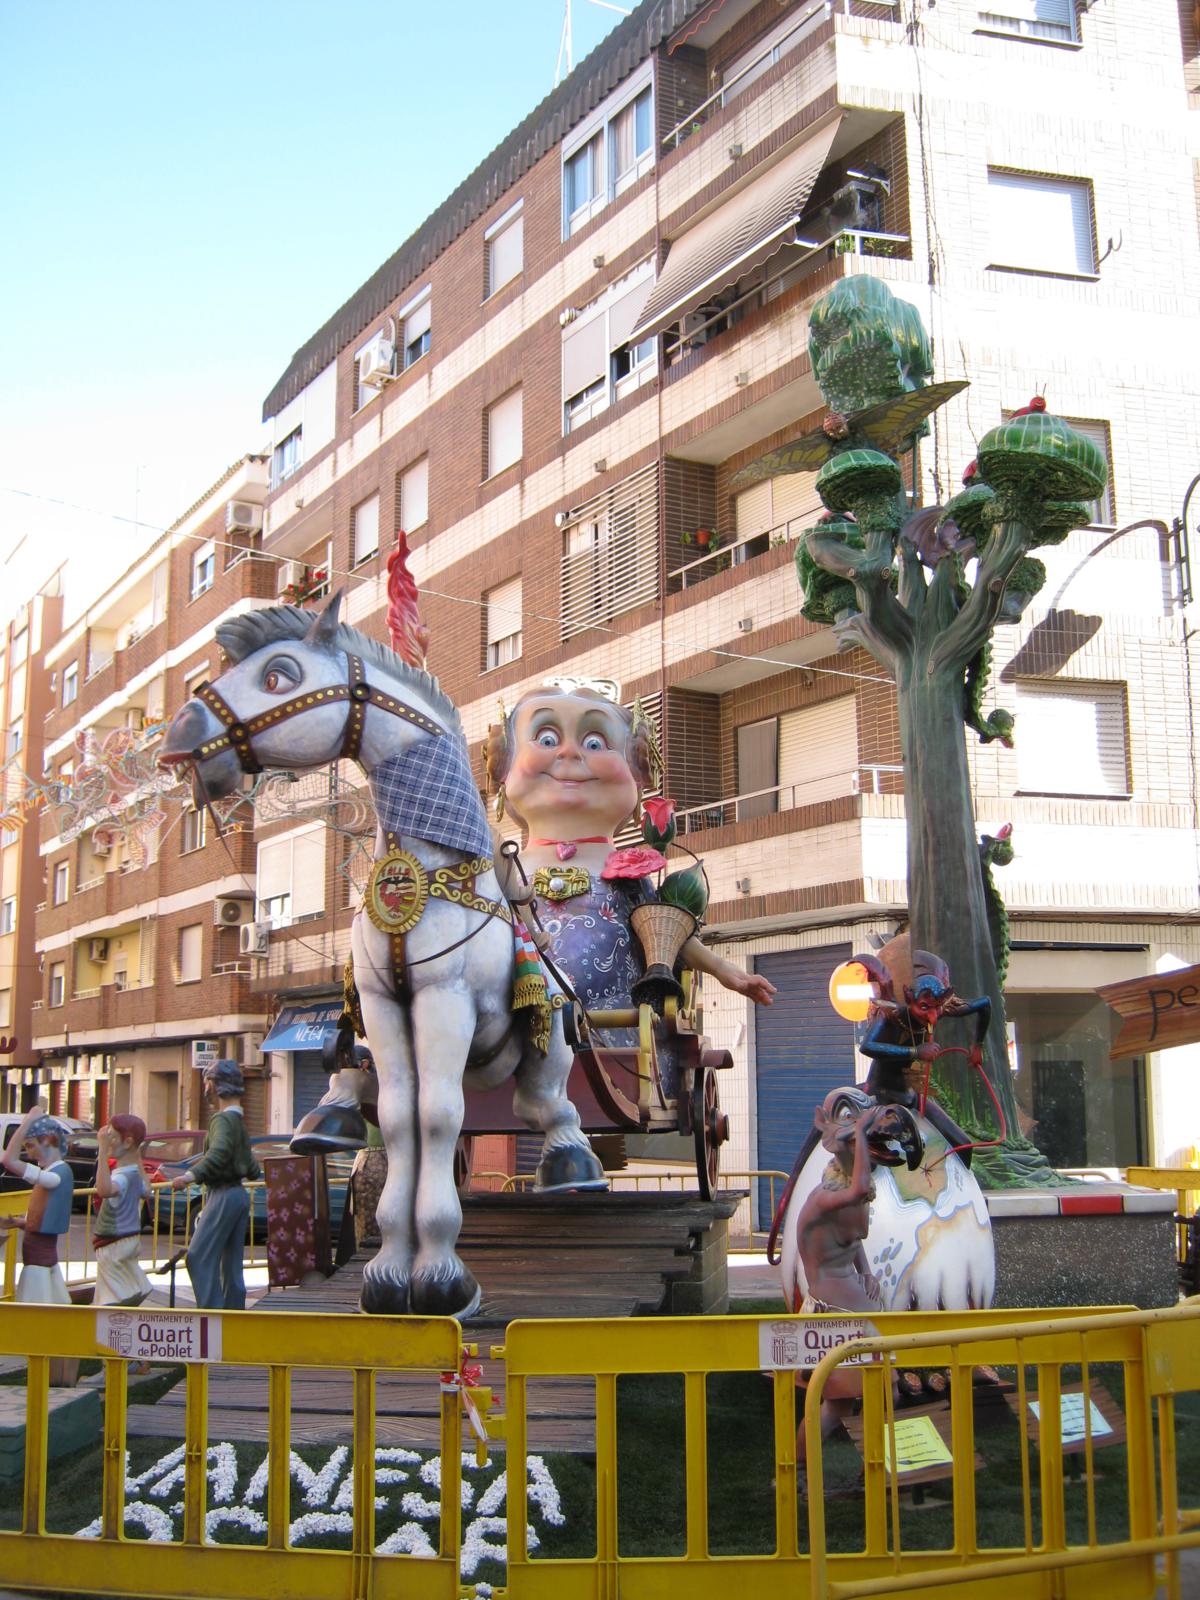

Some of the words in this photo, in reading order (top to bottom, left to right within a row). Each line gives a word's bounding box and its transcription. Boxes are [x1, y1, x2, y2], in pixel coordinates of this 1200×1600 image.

[138, 1314, 182, 1324] AJUNTAMENT
[804, 1320, 851, 1329] AJUNTAMENT
[855, 1319, 864, 1327] DE
[138, 1323, 193, 1343] Quart
